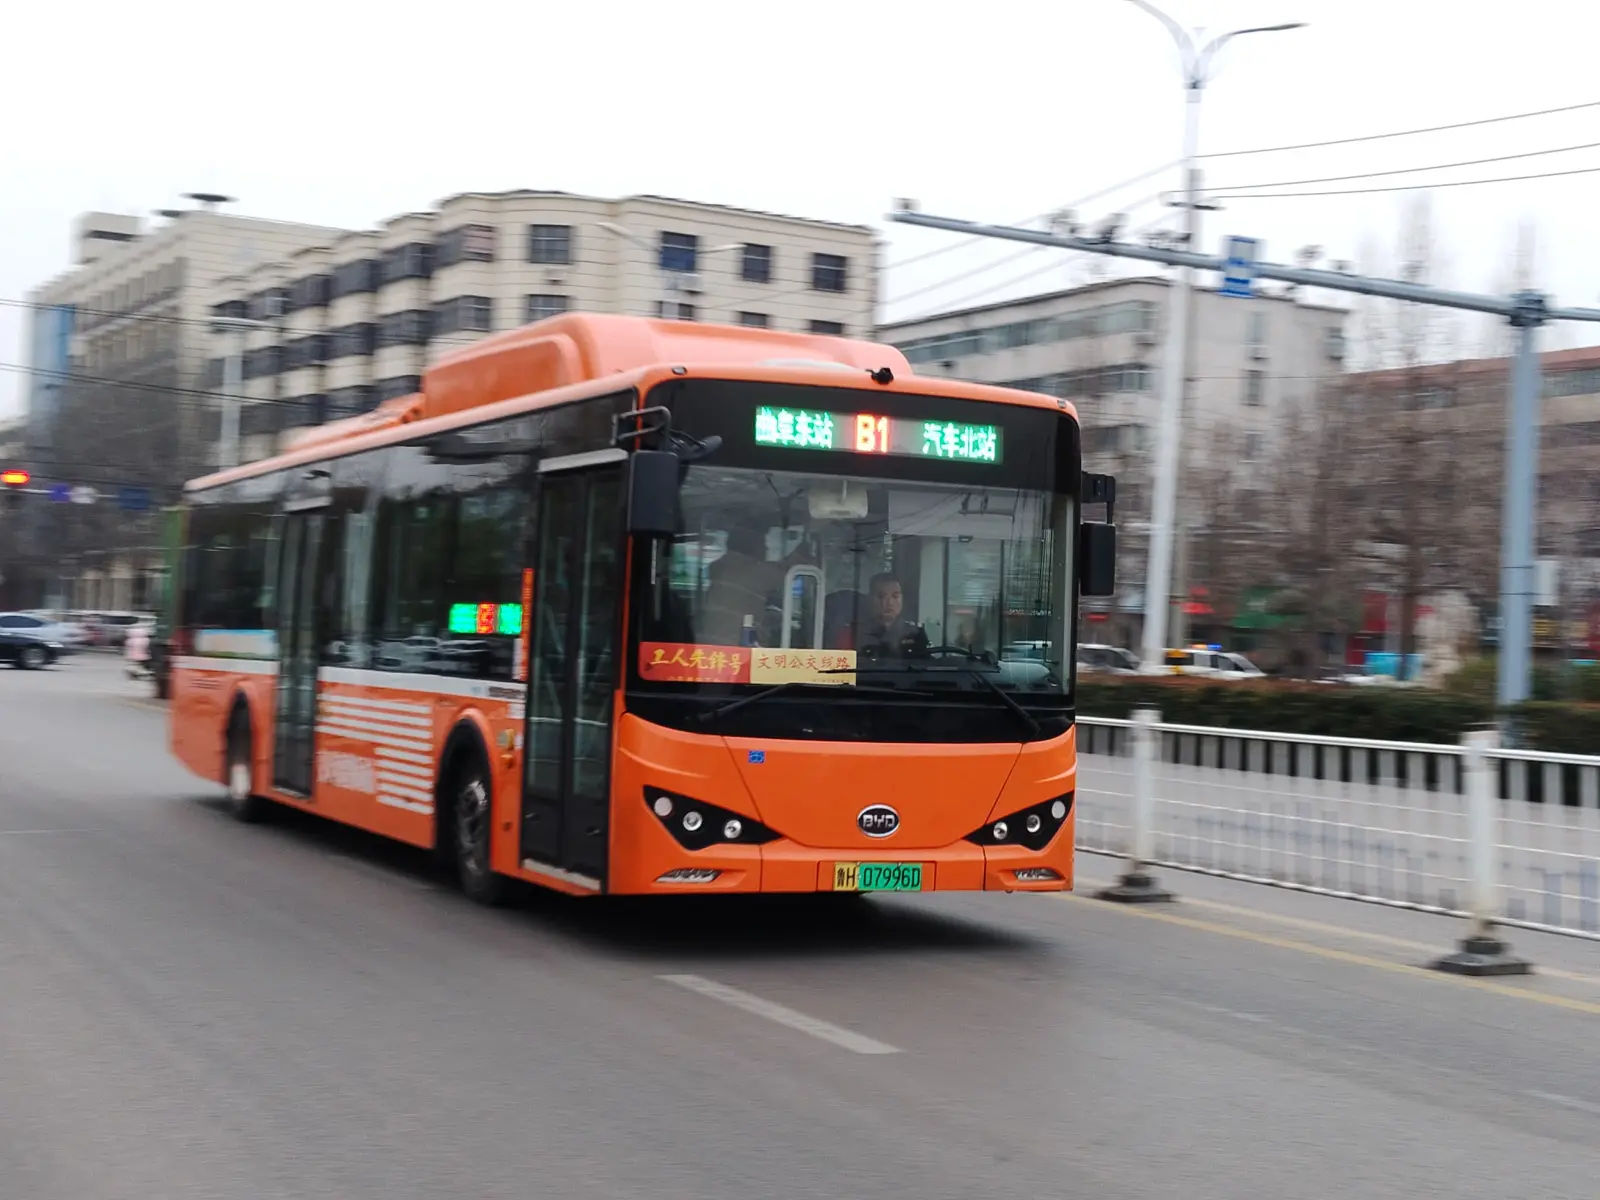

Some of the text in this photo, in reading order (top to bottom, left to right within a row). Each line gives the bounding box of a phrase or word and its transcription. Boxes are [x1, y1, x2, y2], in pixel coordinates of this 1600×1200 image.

[856, 414, 888, 453] B1
[922, 422, 997, 461] 汽车北站
[650, 648, 743, 676] 工人先锋号
[757, 654, 852, 671] 文明公交线路
[862, 814, 895, 828] BYD
